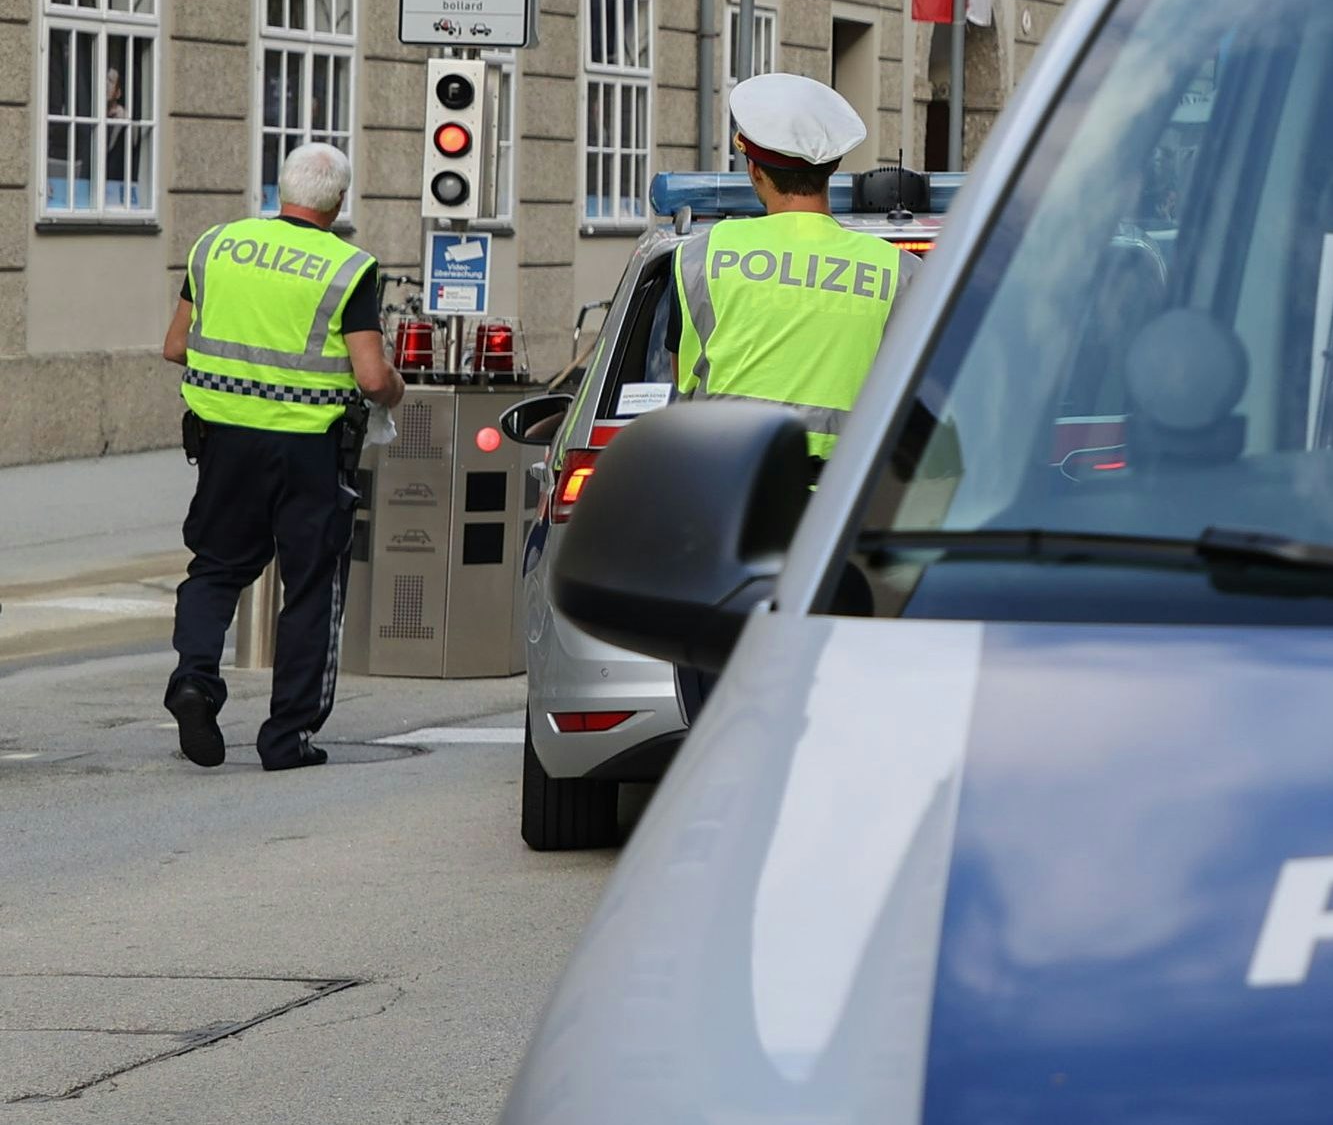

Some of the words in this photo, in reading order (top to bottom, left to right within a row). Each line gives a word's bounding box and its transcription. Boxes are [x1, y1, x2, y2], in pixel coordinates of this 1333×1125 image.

[442, 0, 484, 11] bollard
[213, 238, 332, 283] POLIZEI
[711, 249, 892, 302] POLIZEI
